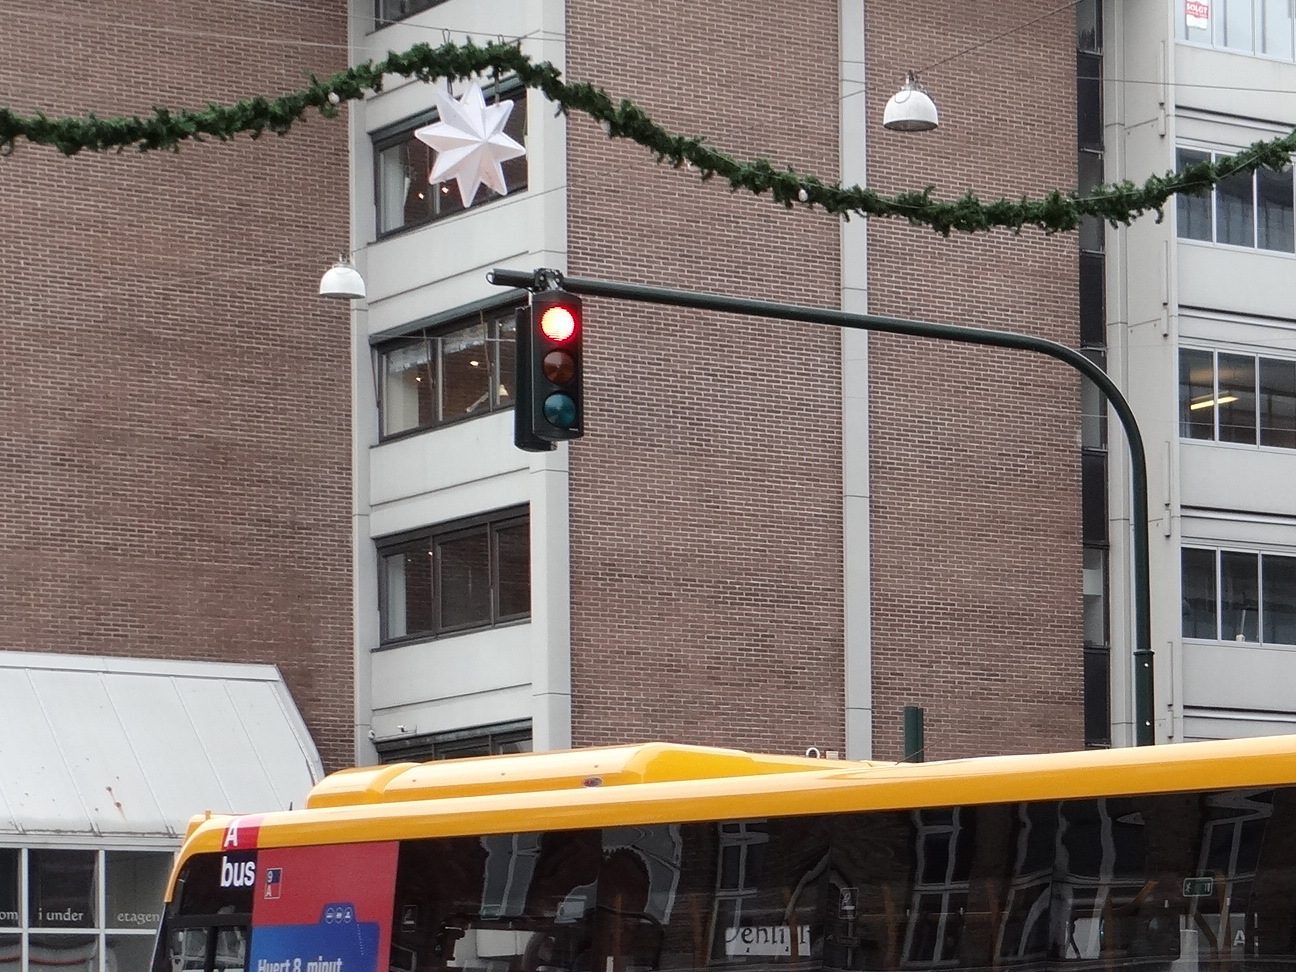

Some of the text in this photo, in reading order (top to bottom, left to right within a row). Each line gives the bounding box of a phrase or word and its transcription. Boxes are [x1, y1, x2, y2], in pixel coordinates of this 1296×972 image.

[223, 817, 242, 848] A
[220, 855, 257, 887] bus
[46, 907, 84, 922] under
